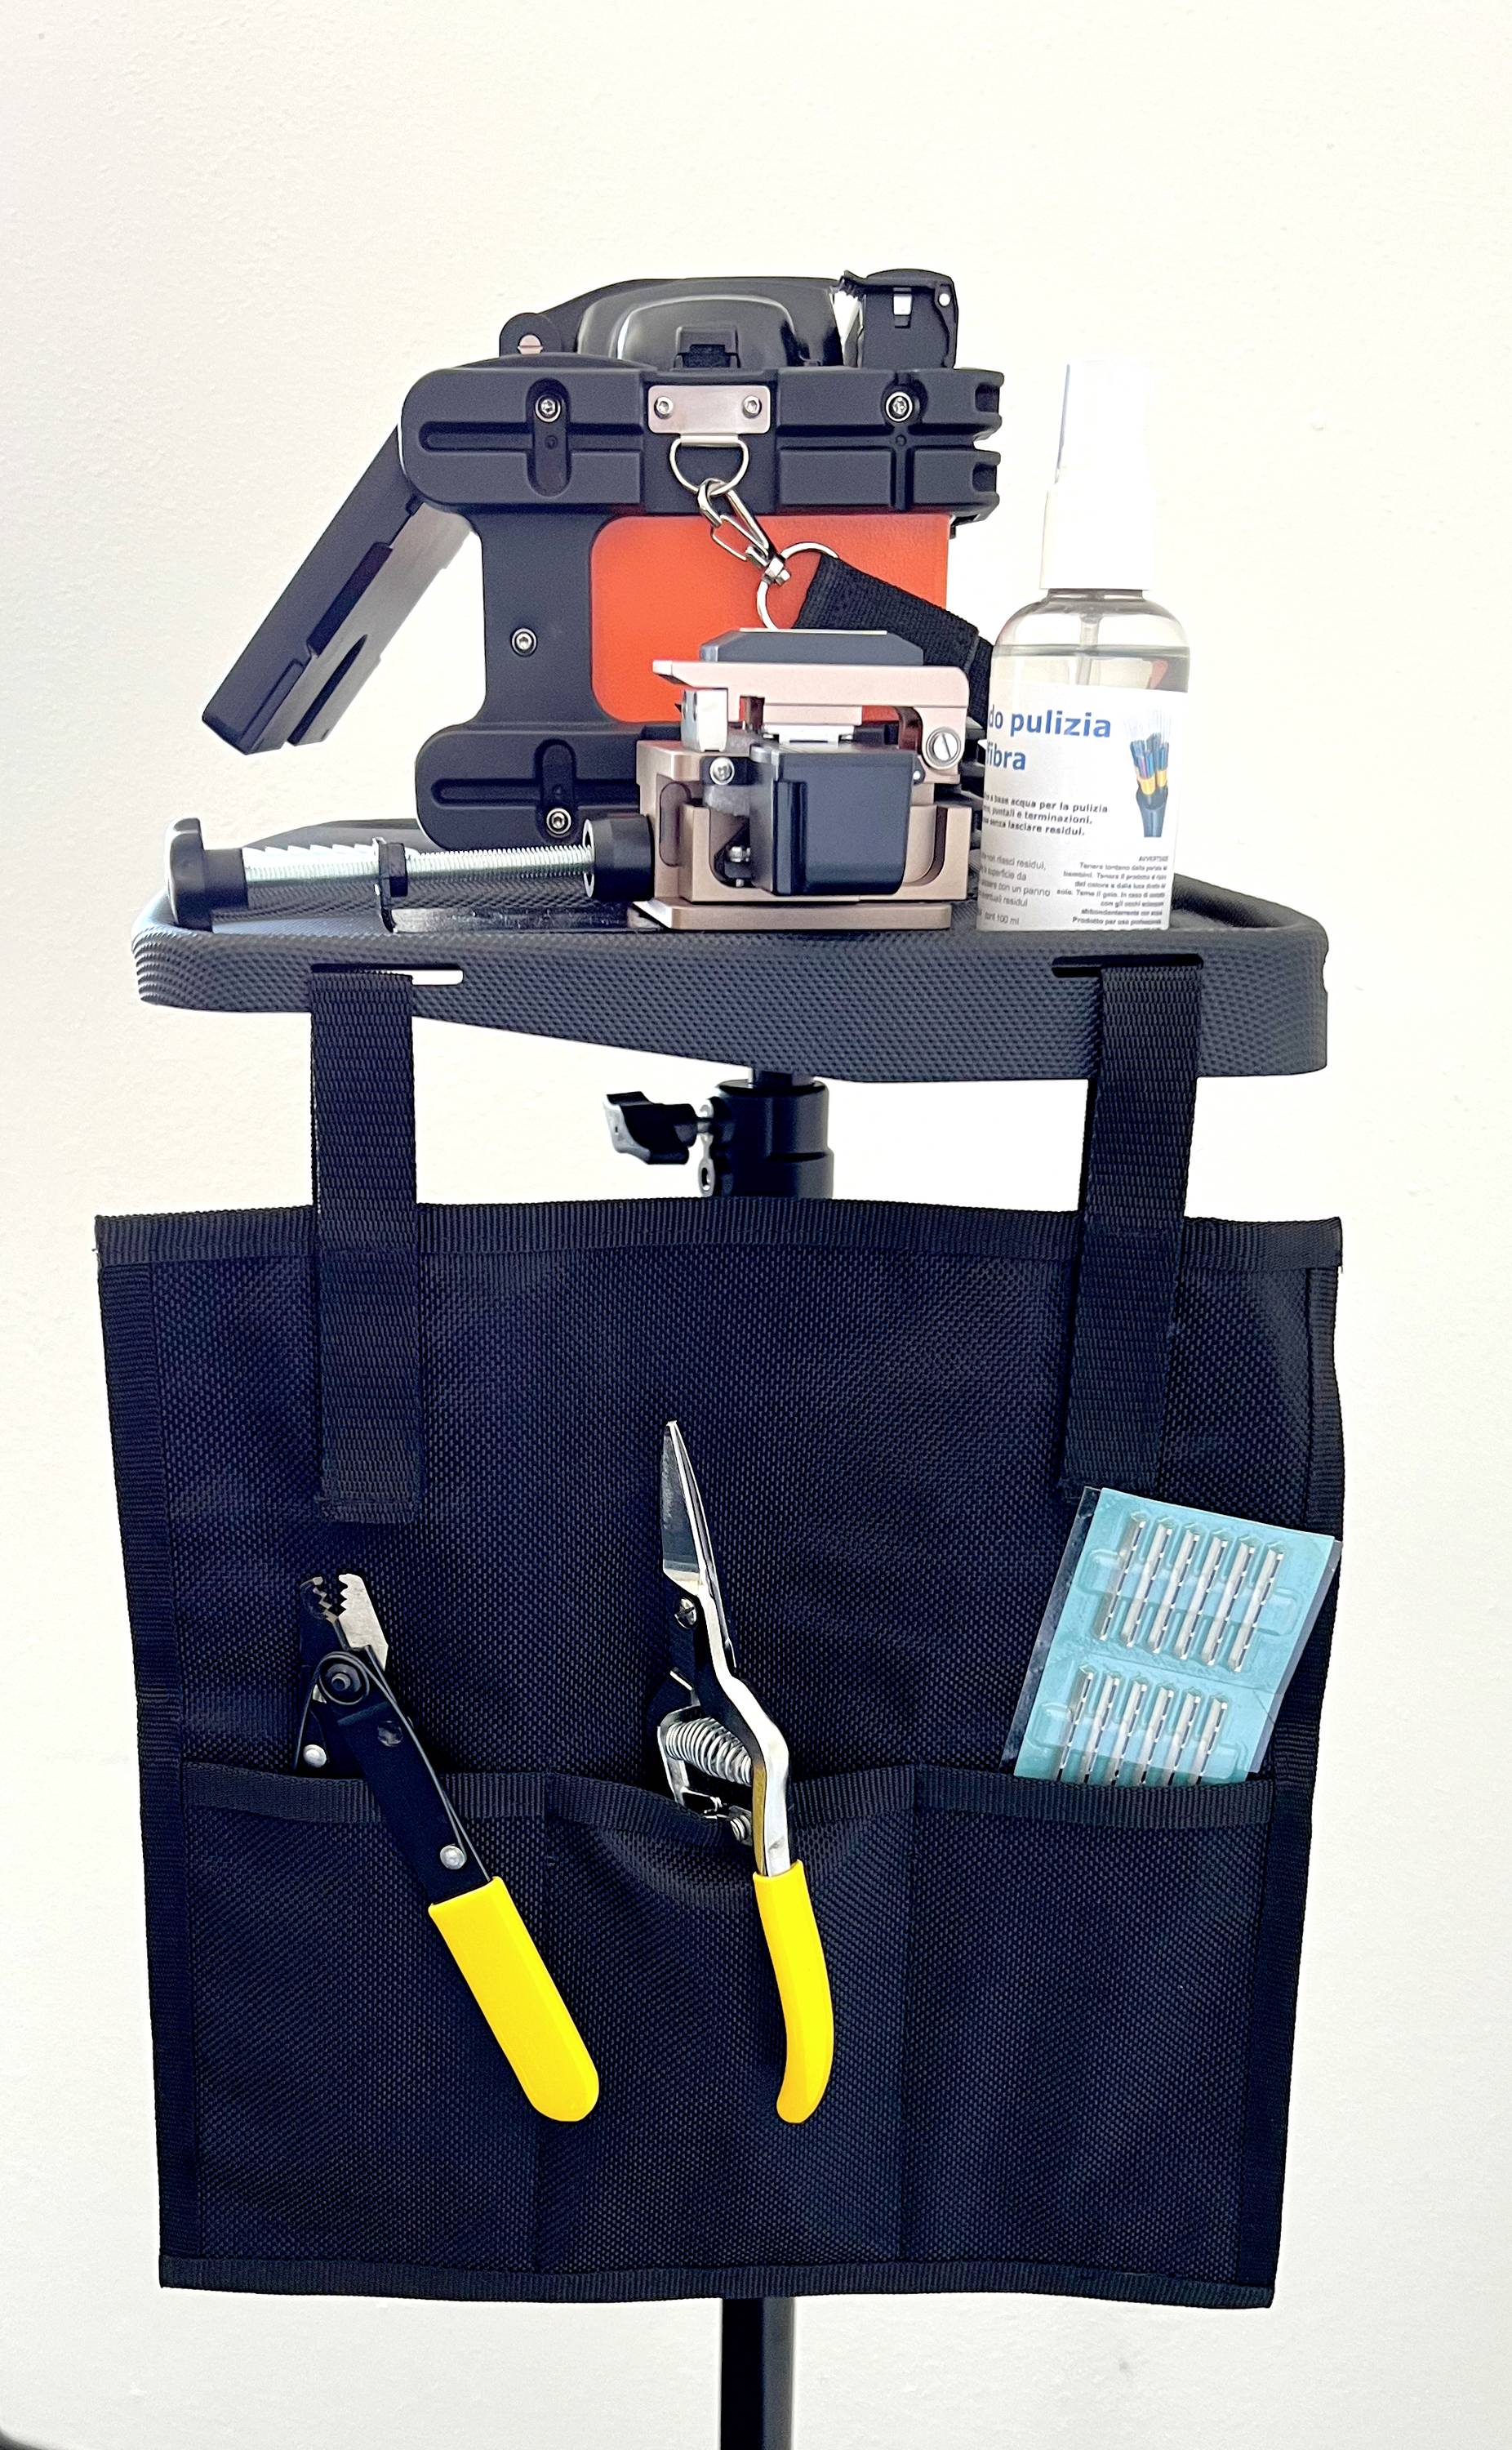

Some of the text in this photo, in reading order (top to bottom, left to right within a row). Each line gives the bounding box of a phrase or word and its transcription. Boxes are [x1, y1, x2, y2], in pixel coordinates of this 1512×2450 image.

[1010, 710, 1111, 737] pulizia
[986, 741, 1026, 770] fibra
[1011, 799, 1036, 808] acqua
[1039, 801, 1056, 810] per
[1060, 802, 1069, 811] la
[1073, 804, 1108, 813] pulizia
[1025, 812, 1092, 825] terminazioni.
[1008, 821, 1043, 833] lasciare
[1045, 826, 1085, 836] residui.
[1016, 871, 1026, 881] da
[1024, 887, 1051, 897] panno
